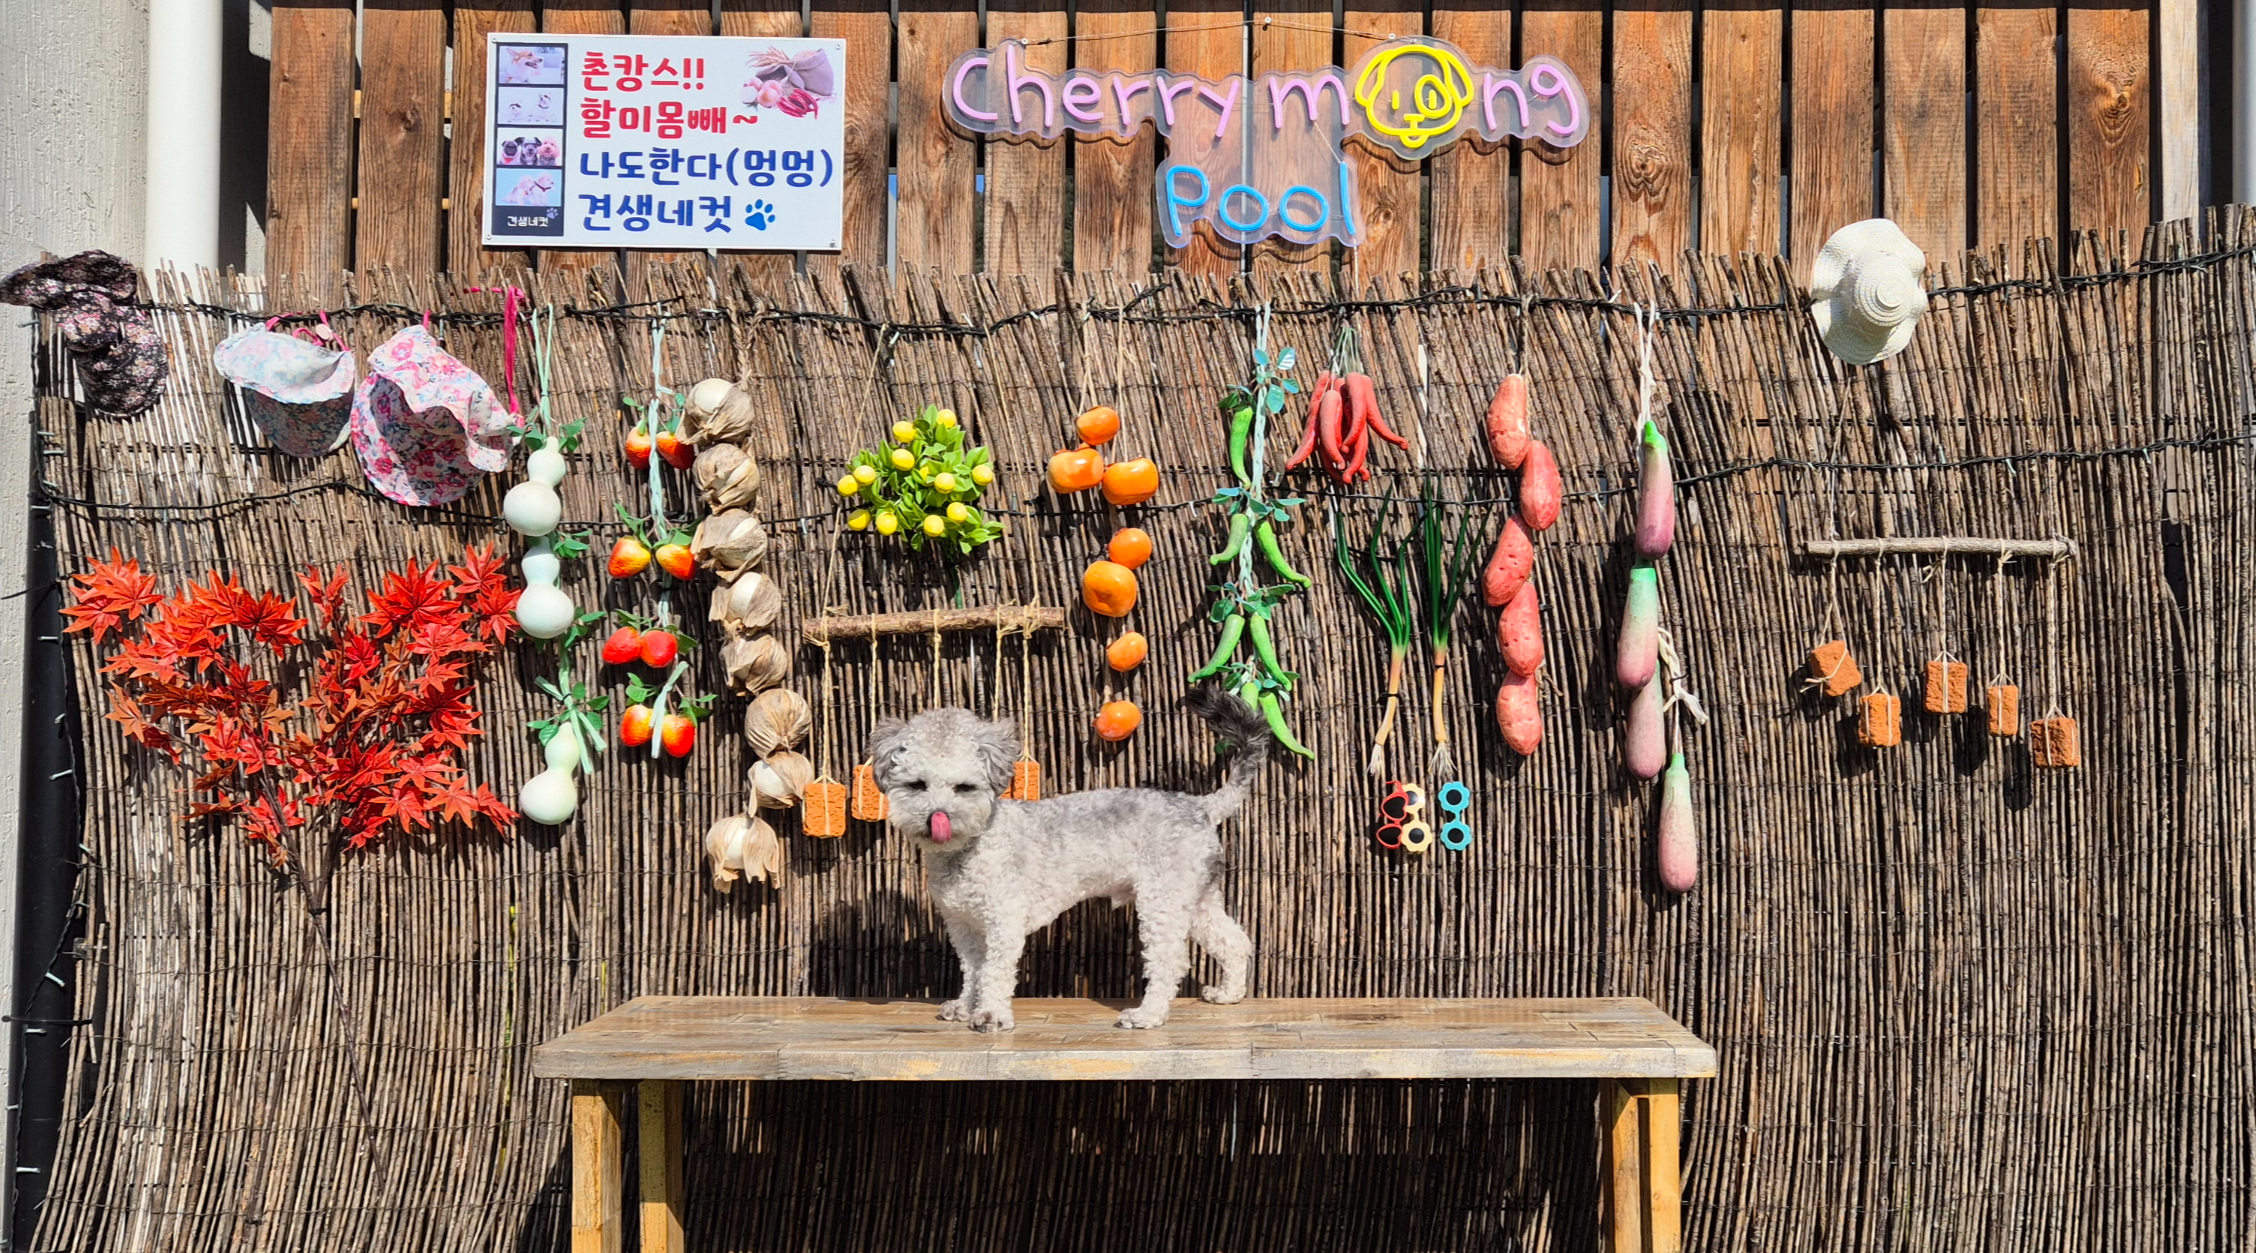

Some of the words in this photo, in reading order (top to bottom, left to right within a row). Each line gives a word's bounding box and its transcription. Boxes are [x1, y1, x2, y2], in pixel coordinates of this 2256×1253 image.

[580, 51, 705, 92] 촌캉스!!
[953, 44, 1239, 138] Cherry
[579, 147, 833, 188] 나도한다(멍멍)
[578, 194, 732, 233] 견생네컷
[1165, 161, 1356, 236] Pool
[507, 216, 549, 227] 견생네컷
